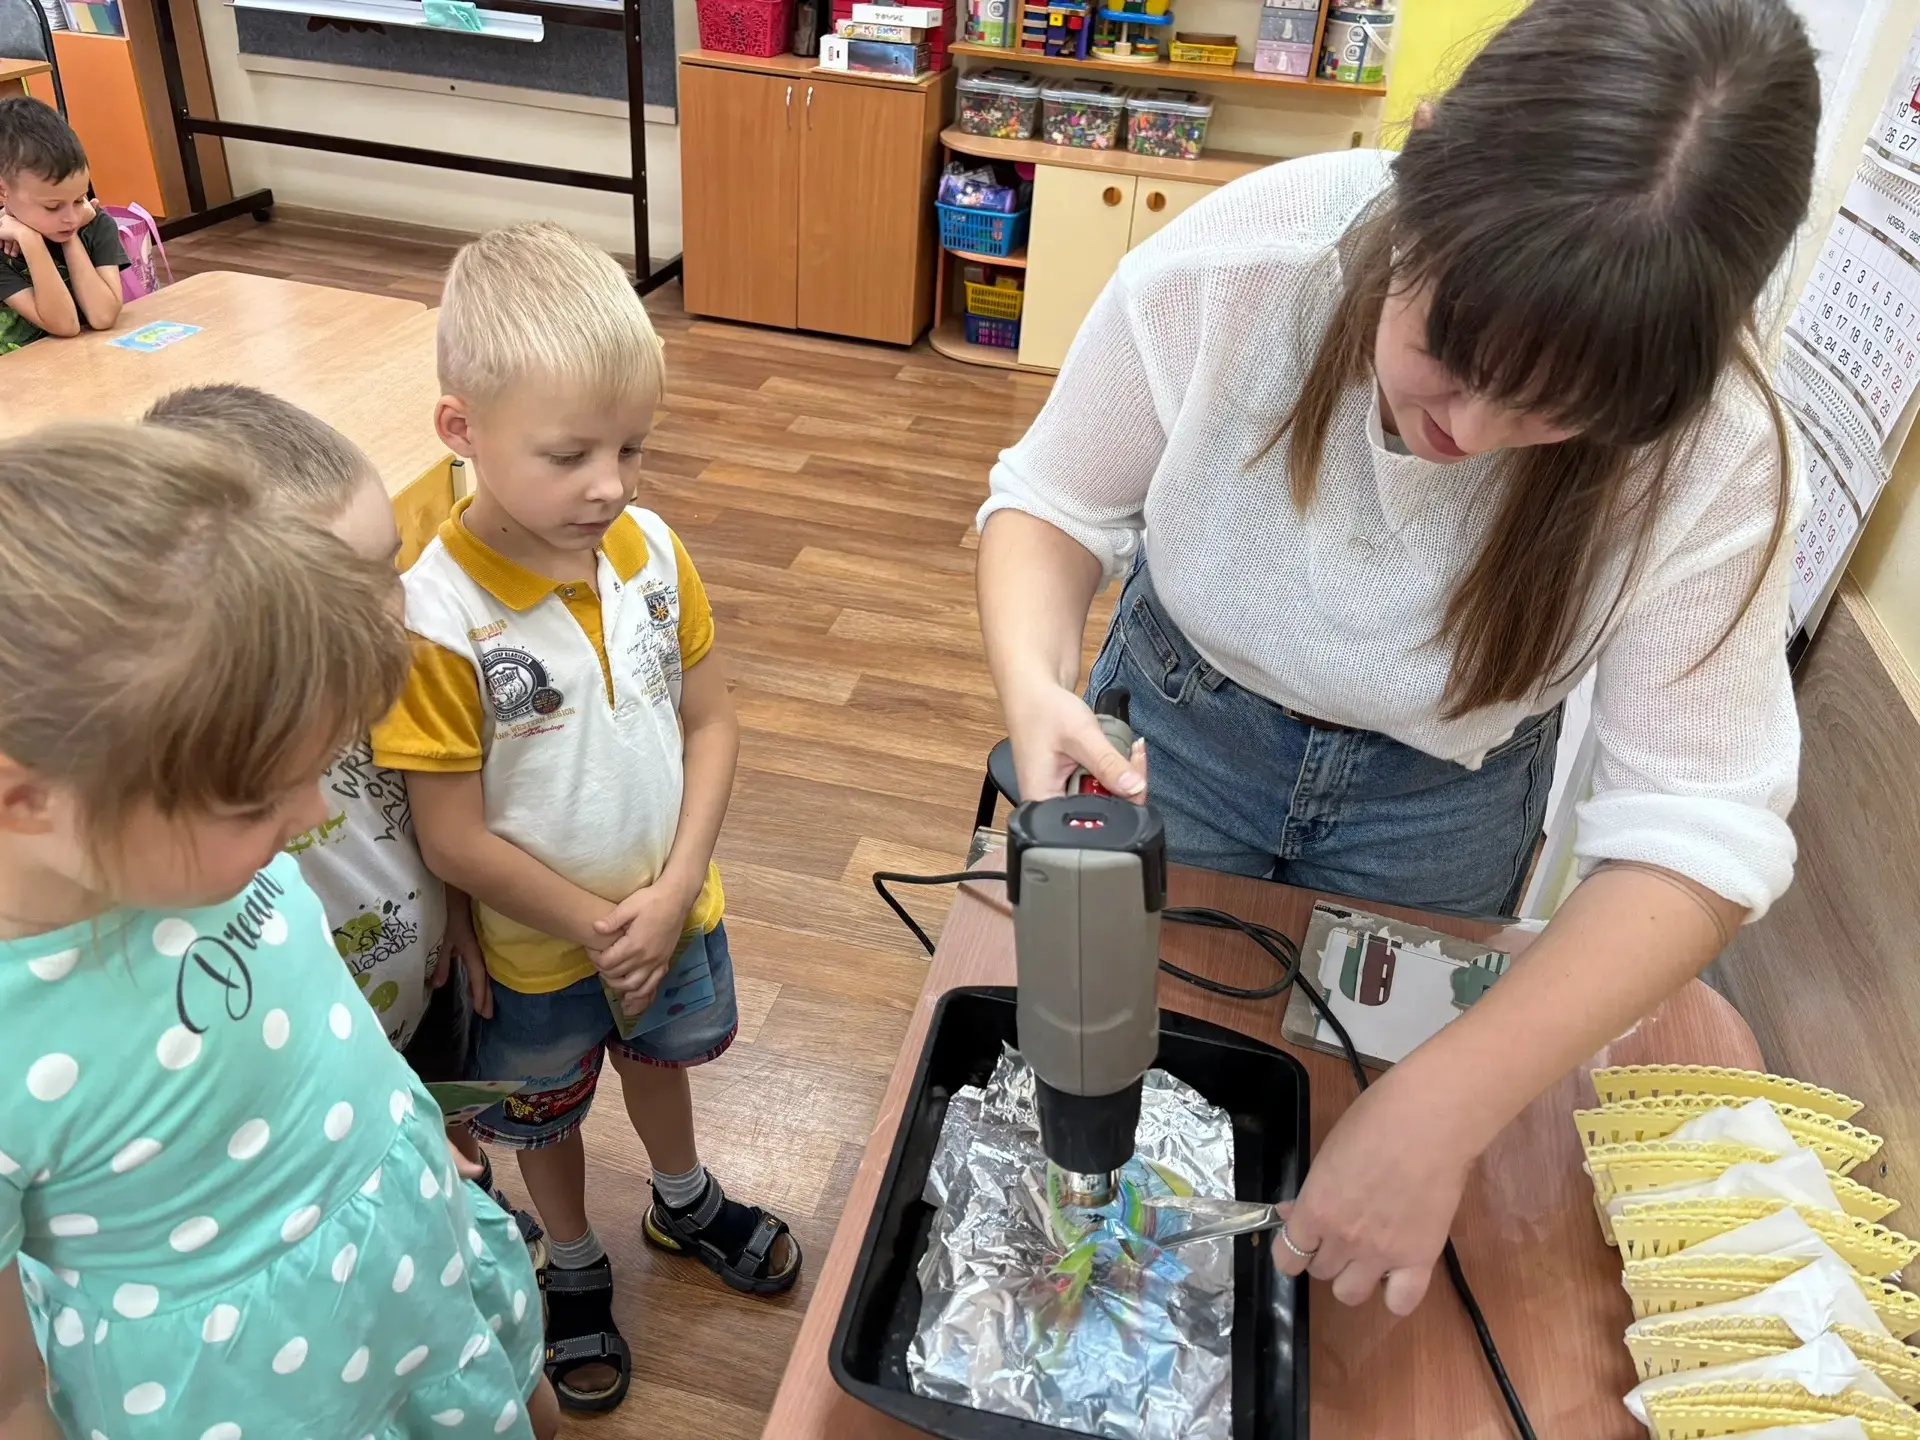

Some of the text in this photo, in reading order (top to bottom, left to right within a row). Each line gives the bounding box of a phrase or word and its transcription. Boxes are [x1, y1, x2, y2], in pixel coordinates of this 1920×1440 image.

[1896, 101, 1909, 118] 19
[1884, 126, 1918, 151] 26 27
[1842, 258, 1851, 273] 2
[1857, 269, 1866, 284] 3
[1872, 281, 1880, 295] 4
[1883, 291, 1892, 306] 5
[1895, 302, 1904, 318] 6
[1906, 314, 1915, 328] 7
[1821, 302, 1833, 319] 16
[1835, 314, 1848, 330] 17
[1849, 326, 1861, 344] 18
[1861, 338, 1873, 355] 19
[1871, 350, 1884, 368] 20
[1881, 362, 1893, 380] 21
[1891, 374, 1902, 394] 22
[1832, 281, 1841, 296] 9
[1846, 291, 1858, 309] 10
[1859, 302, 1871, 320] 11
[1872, 314, 1883, 332] 12
[1883, 326, 1894, 344] 13
[1893, 338, 1905, 356] 14
[1904, 350, 1915, 369] 15
[1824, 336, 1837, 354] 24
[1838, 348, 1851, 366] 25
[1850, 360, 1862, 379] 26
[1861, 373, 1873, 390] 27
[1809, 459, 1817, 473] 3
[1820, 475, 1827, 488] 4
[1828, 488, 1836, 502] 5
[1816, 508, 1827, 527] 12
[511, 714, 547, 733] WESTERN
[547, 707, 576, 721] REGION
[176, 869, 285, 1034] Dream
[352, 928, 418, 977] STREET
